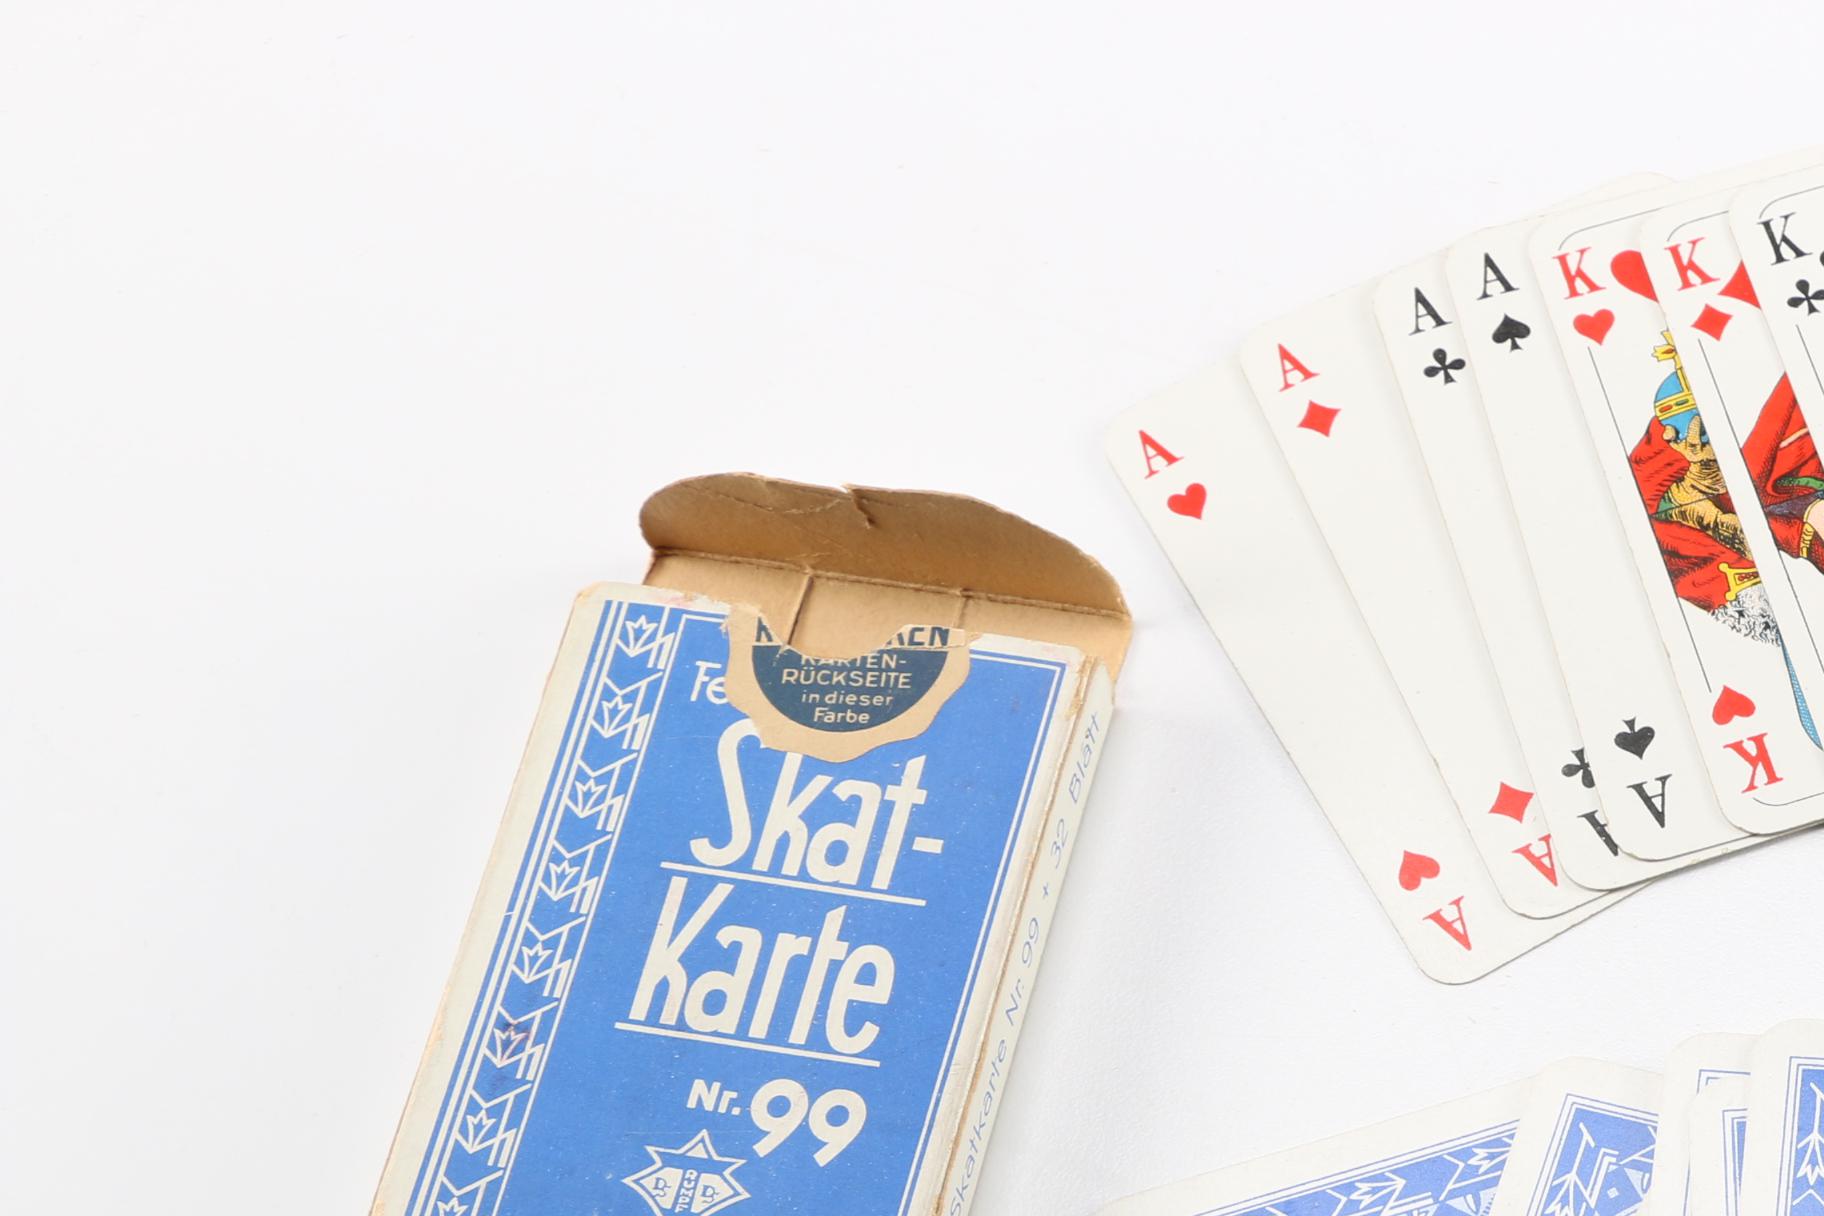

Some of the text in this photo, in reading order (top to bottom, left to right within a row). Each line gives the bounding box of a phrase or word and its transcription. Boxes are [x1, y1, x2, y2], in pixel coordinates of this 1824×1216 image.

[1667, 237, 1720, 291] K
[1758, 213, 1813, 266] K
[1476, 252, 1519, 300] A
[1553, 247, 1607, 299] K
[1408, 286, 1453, 336] A
[1277, 343, 1320, 392] A
[1138, 429, 1184, 479] A
[780, 666, 912, 689] RÜCKSEITE
[801, 690, 894, 707] in dieser
[812, 707, 870, 724] Farbe
[1723, 732, 1783, 794] K
[689, 718, 944, 891] Skat-
[1626, 773, 1673, 829] A
[1511, 833, 1559, 887] A
[1021, 916, 1040, 969] 99
[1050, 817, 1069, 870] 32
[1422, 895, 1473, 952] A
[628, 875, 896, 1055] Karte
[686, 1078, 867, 1168] Nr. 99
[674, 1168, 699, 1213] RUMPF
